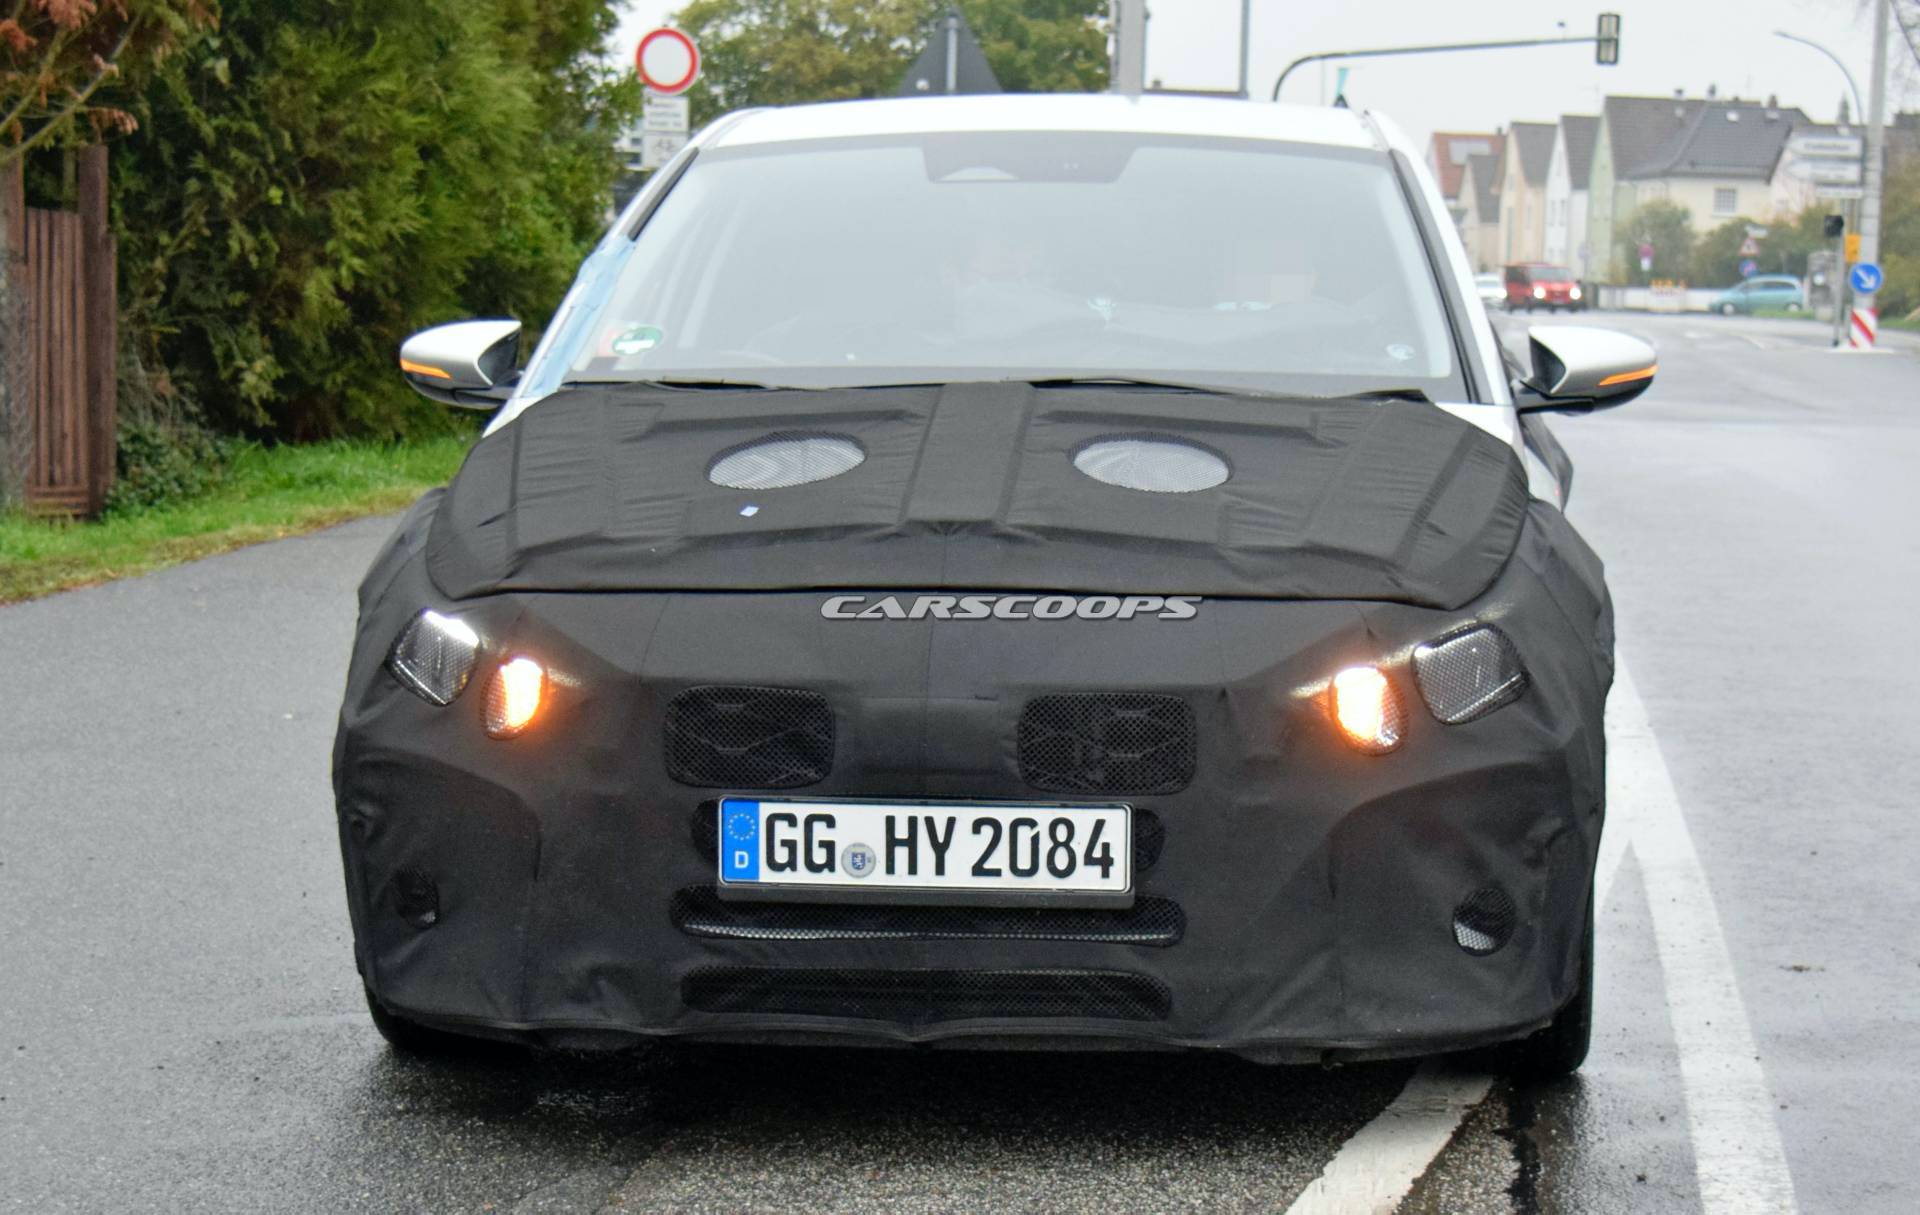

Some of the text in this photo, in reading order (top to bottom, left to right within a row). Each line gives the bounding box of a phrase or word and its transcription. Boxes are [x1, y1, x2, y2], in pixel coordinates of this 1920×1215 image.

[734, 850, 749, 869] D
[766, 812, 1114, 879] GG HY 2084
